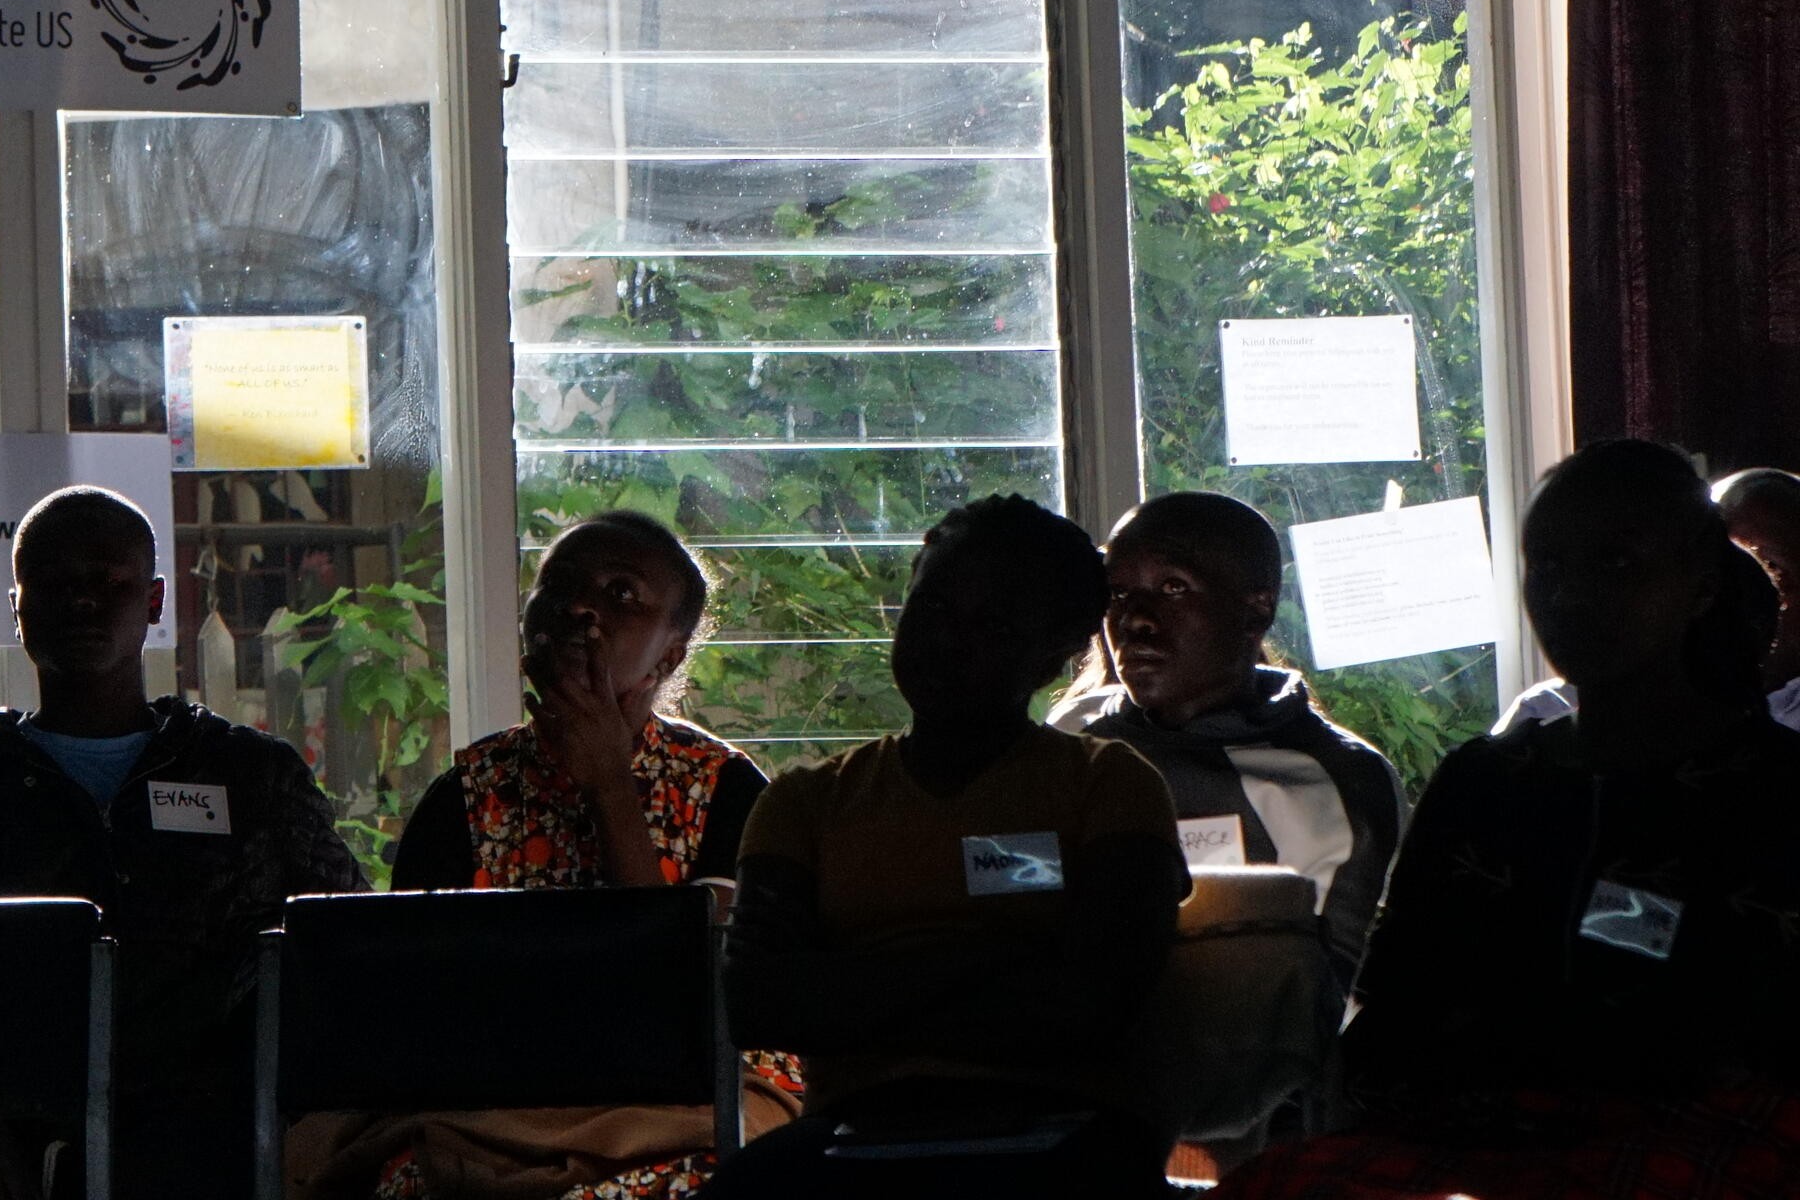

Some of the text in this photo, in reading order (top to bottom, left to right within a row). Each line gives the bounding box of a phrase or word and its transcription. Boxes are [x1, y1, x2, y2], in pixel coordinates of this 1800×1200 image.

[36, 11, 74, 49] US
[152, 790, 210, 809] EVANS
[1179, 830, 1231, 850] RACE
[973, 851, 1026, 872] NAO
